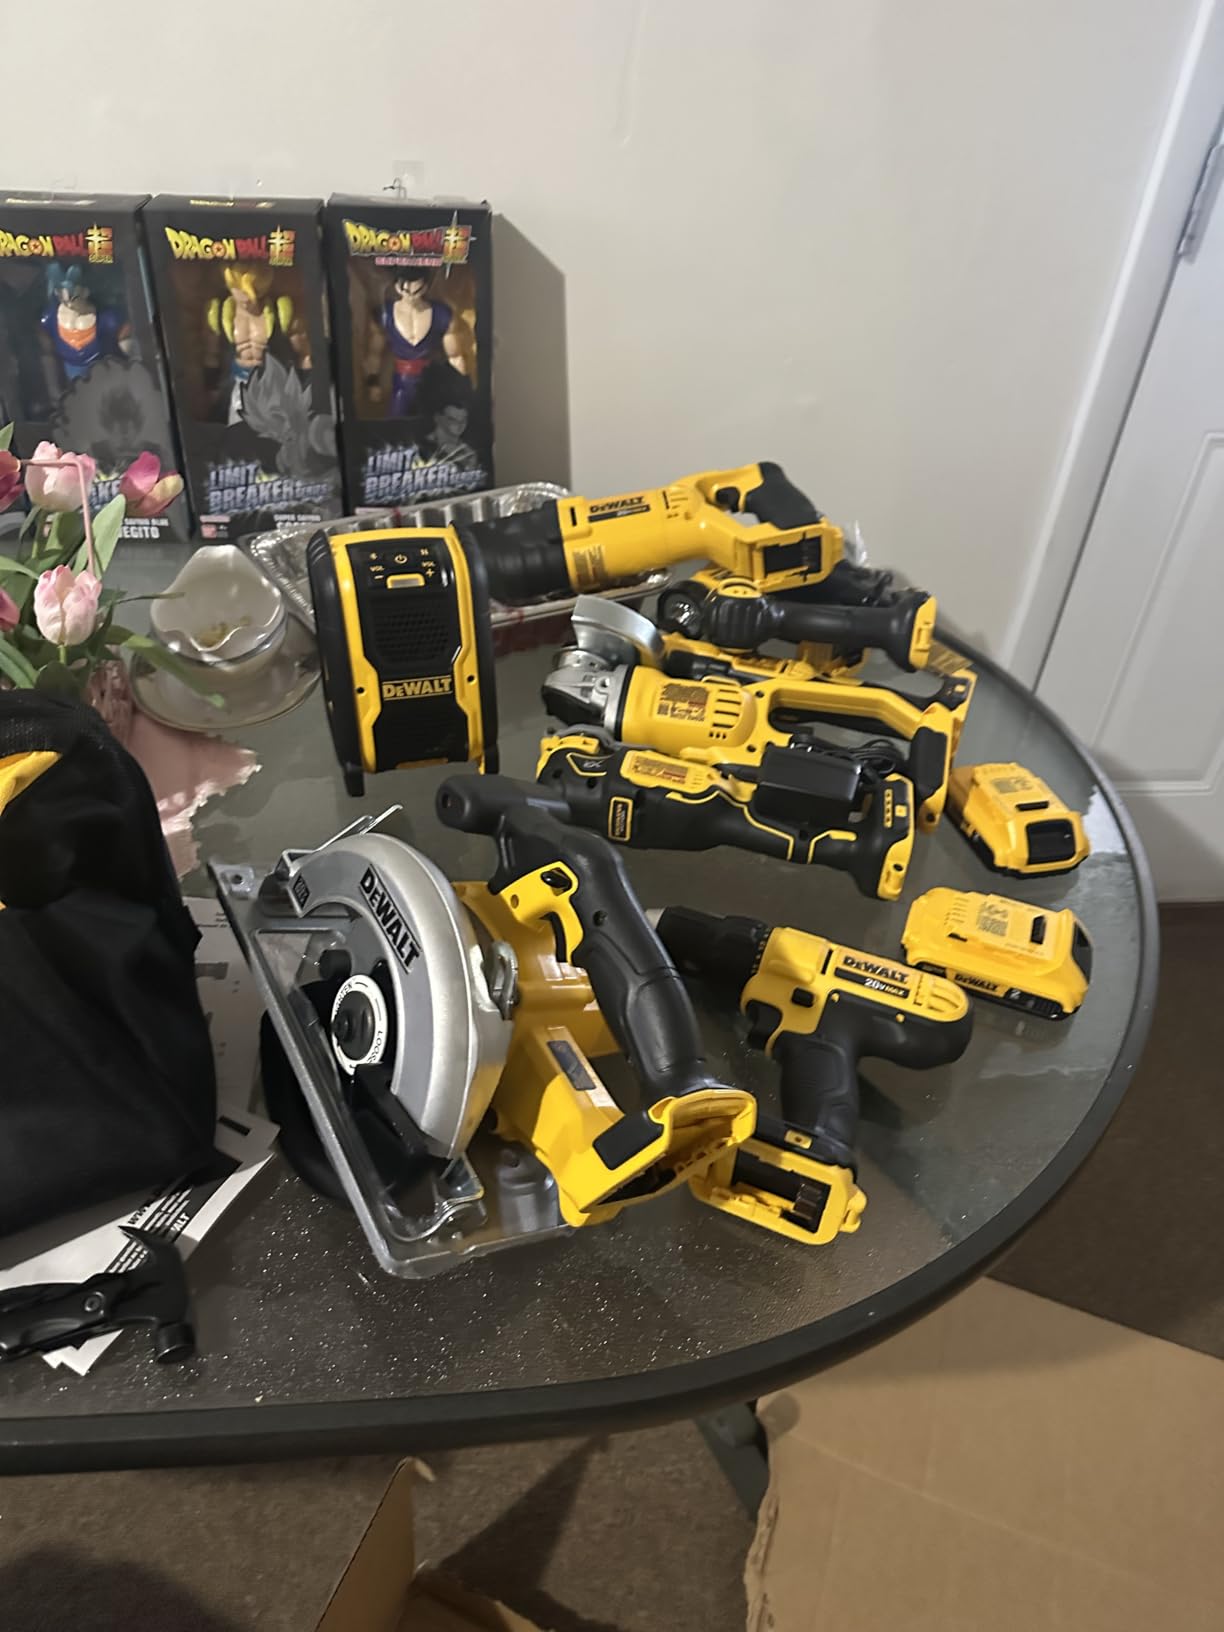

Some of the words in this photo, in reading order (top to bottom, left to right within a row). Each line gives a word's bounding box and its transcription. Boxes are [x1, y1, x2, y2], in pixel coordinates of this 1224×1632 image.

[0, 229, 54, 257] RAGON
[165, 227, 236, 260] DRAGON
[343, 220, 411, 253] DRAGON
[209, 463, 257, 489] LIMIT
[367, 449, 416, 475] LIMIT
[209, 480, 297, 512] BREAKER
[365, 464, 449, 500] BREAKER
[383, 678, 452, 699] DEWALT
[360, 868, 420, 968] DEWALT
[843, 955, 910, 984] DEWALT
